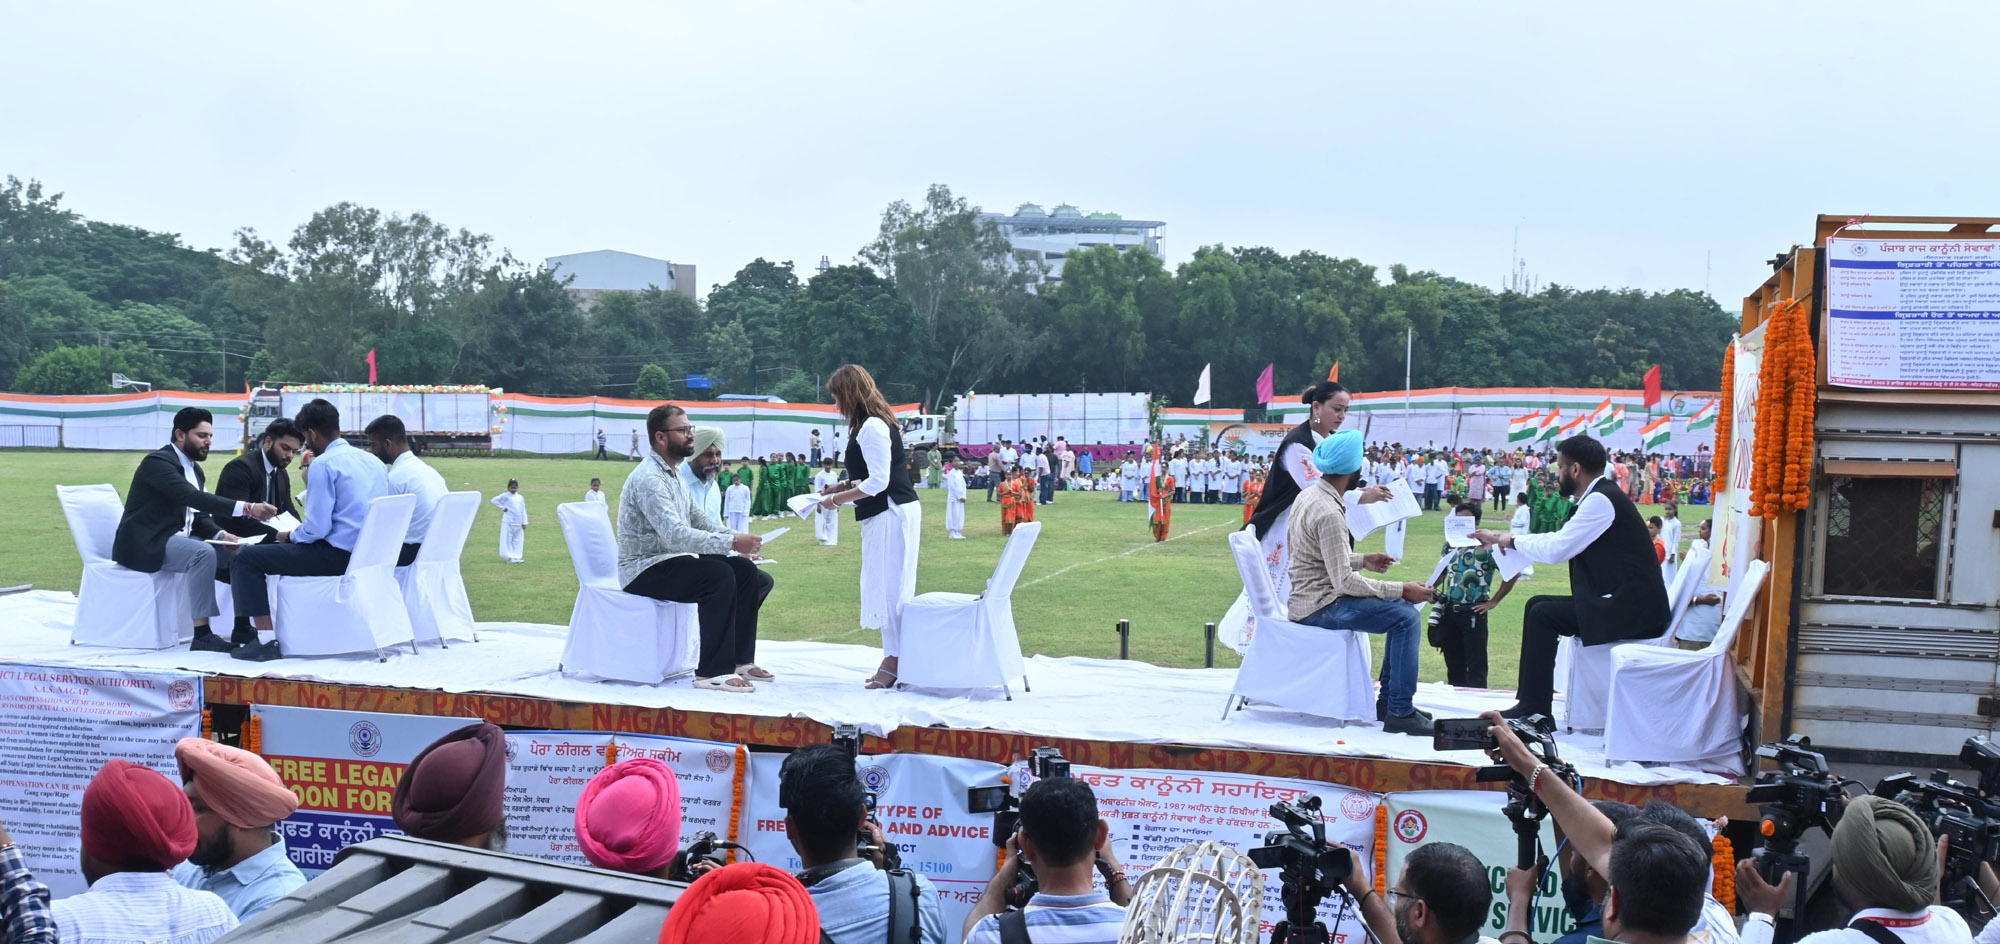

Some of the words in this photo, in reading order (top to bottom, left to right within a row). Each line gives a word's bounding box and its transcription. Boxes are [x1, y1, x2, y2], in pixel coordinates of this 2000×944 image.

[17, 672, 49, 682] LEGAL
[50, 674, 94, 685] SERVICES
[57, 686, 89, 695] NAGAR
[220, 678, 287, 705] PLOT
[340, 687, 388, 712] 177
[592, 704, 688, 739] NAGAR
[555, 741, 592, 756] ਲੀਗਲ
[270, 758, 328, 783] FREE
[289, 784, 339, 809] OON
[1130, 775, 1205, 798] ਕਾਨੂੰਨੀ
[1211, 780, 1309, 803] ਸਹਾਇਤਾ
[877, 805, 917, 819] TYPE
[922, 806, 943, 820] OF
[888, 822, 923, 835] AND
[927, 824, 989, 839] ADVICE
[920, 861, 953, 874] 15100
